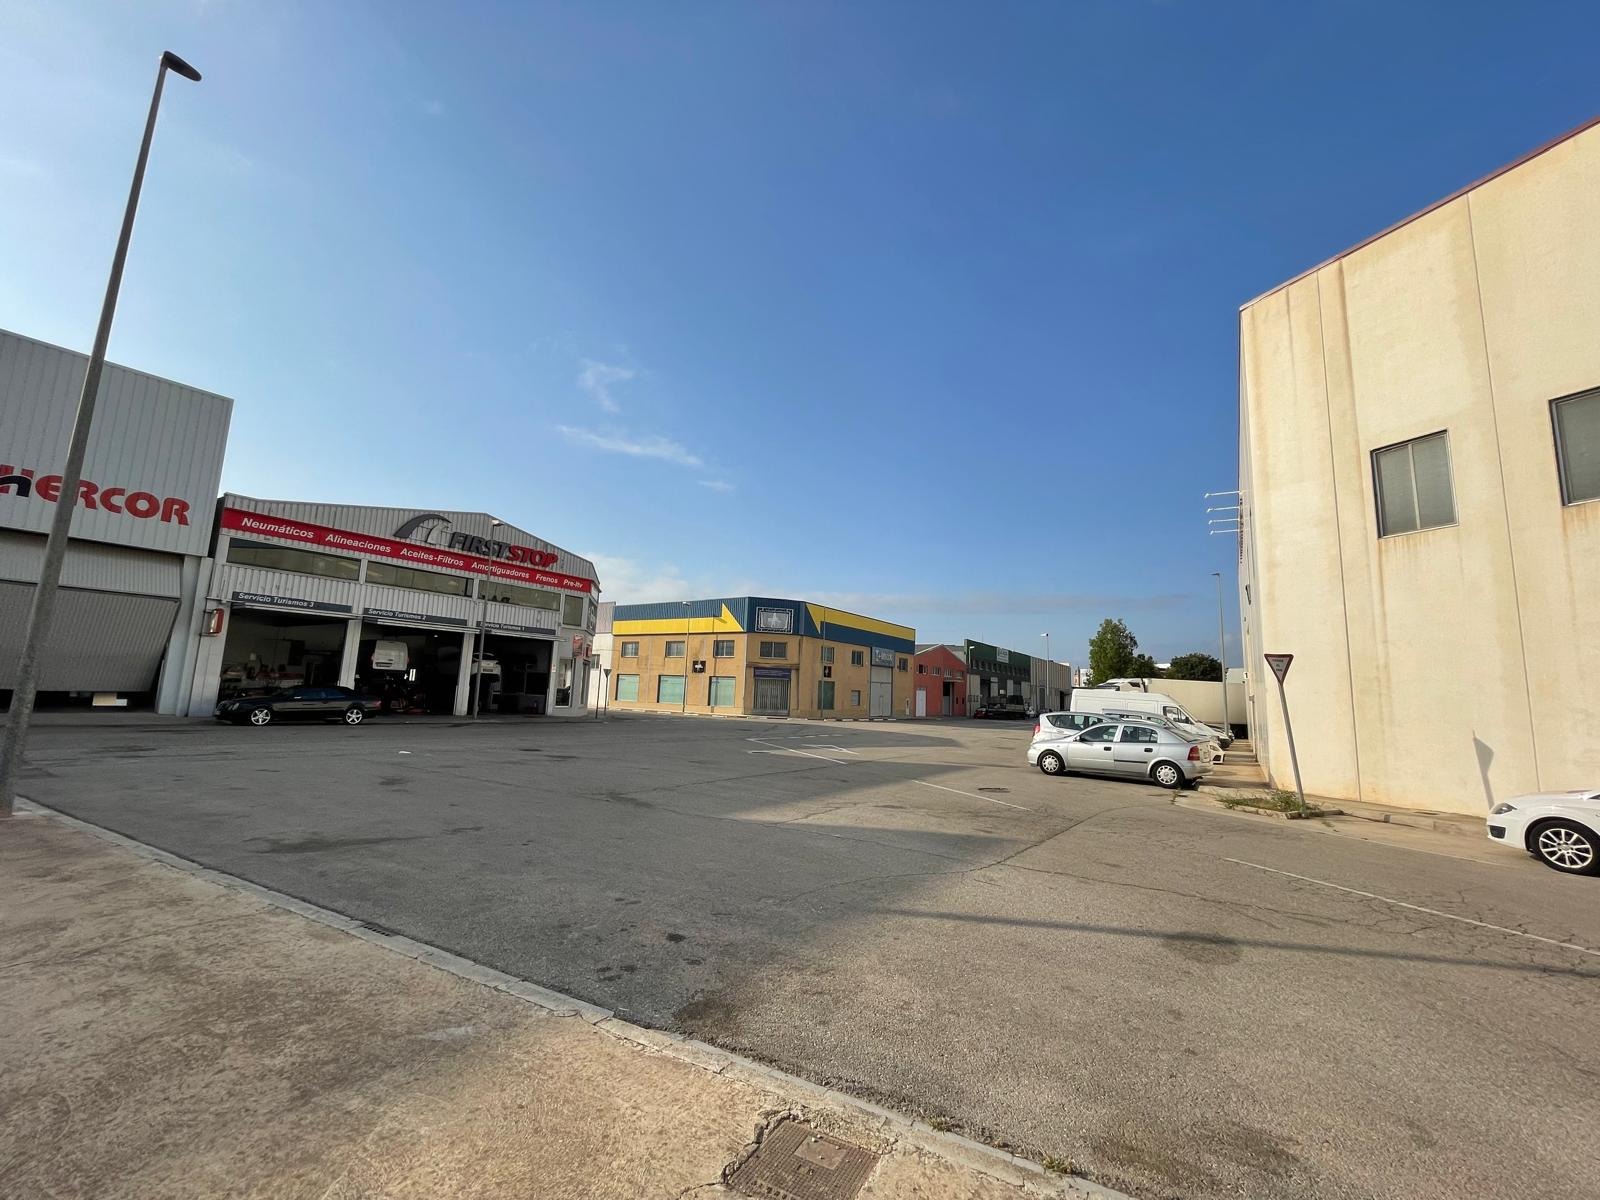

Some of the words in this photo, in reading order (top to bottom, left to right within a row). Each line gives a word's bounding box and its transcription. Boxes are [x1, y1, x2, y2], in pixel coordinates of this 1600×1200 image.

[241, 517, 315, 539] Neumáticos
[325, 533, 392, 553] Alineaciones
[400, 547, 464, 567] Aceites-Filtros
[471, 561, 530, 579] Amortiguadores
[535, 573, 558, 584] Frenos
[238, 592, 271, 602] Servicio
[273, 596, 307, 607] Turismos
[368, 608, 394, 617] Servicio
[394, 611, 422, 620] Turismos
